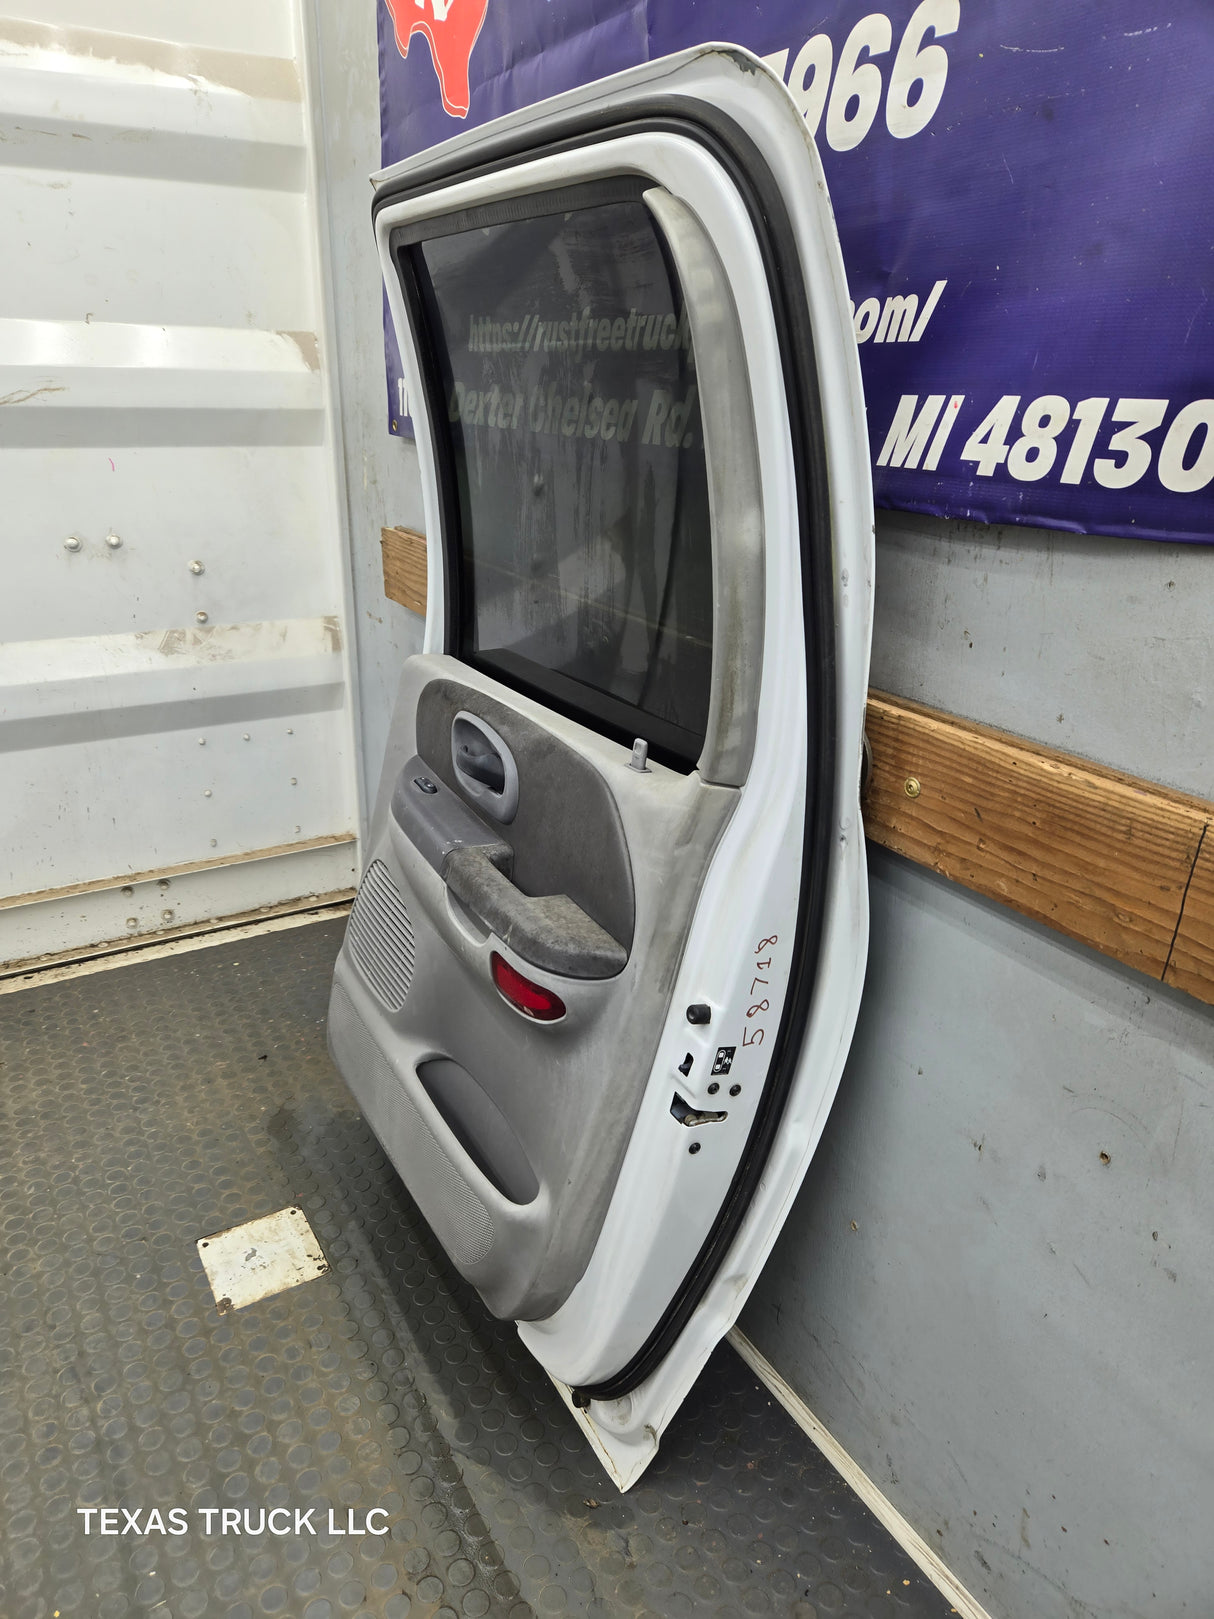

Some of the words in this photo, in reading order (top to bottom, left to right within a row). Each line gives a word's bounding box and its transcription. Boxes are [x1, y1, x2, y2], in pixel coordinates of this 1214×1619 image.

[760, 0, 961, 152] 966
[468, 308, 694, 363] https://rustfreetruck
[850, 280, 948, 344] om/
[449, 381, 524, 429] Dexter
[530, 382, 638, 441] Chelsea
[876, 394, 966, 471] MI
[959, 394, 1214, 493] 48130
